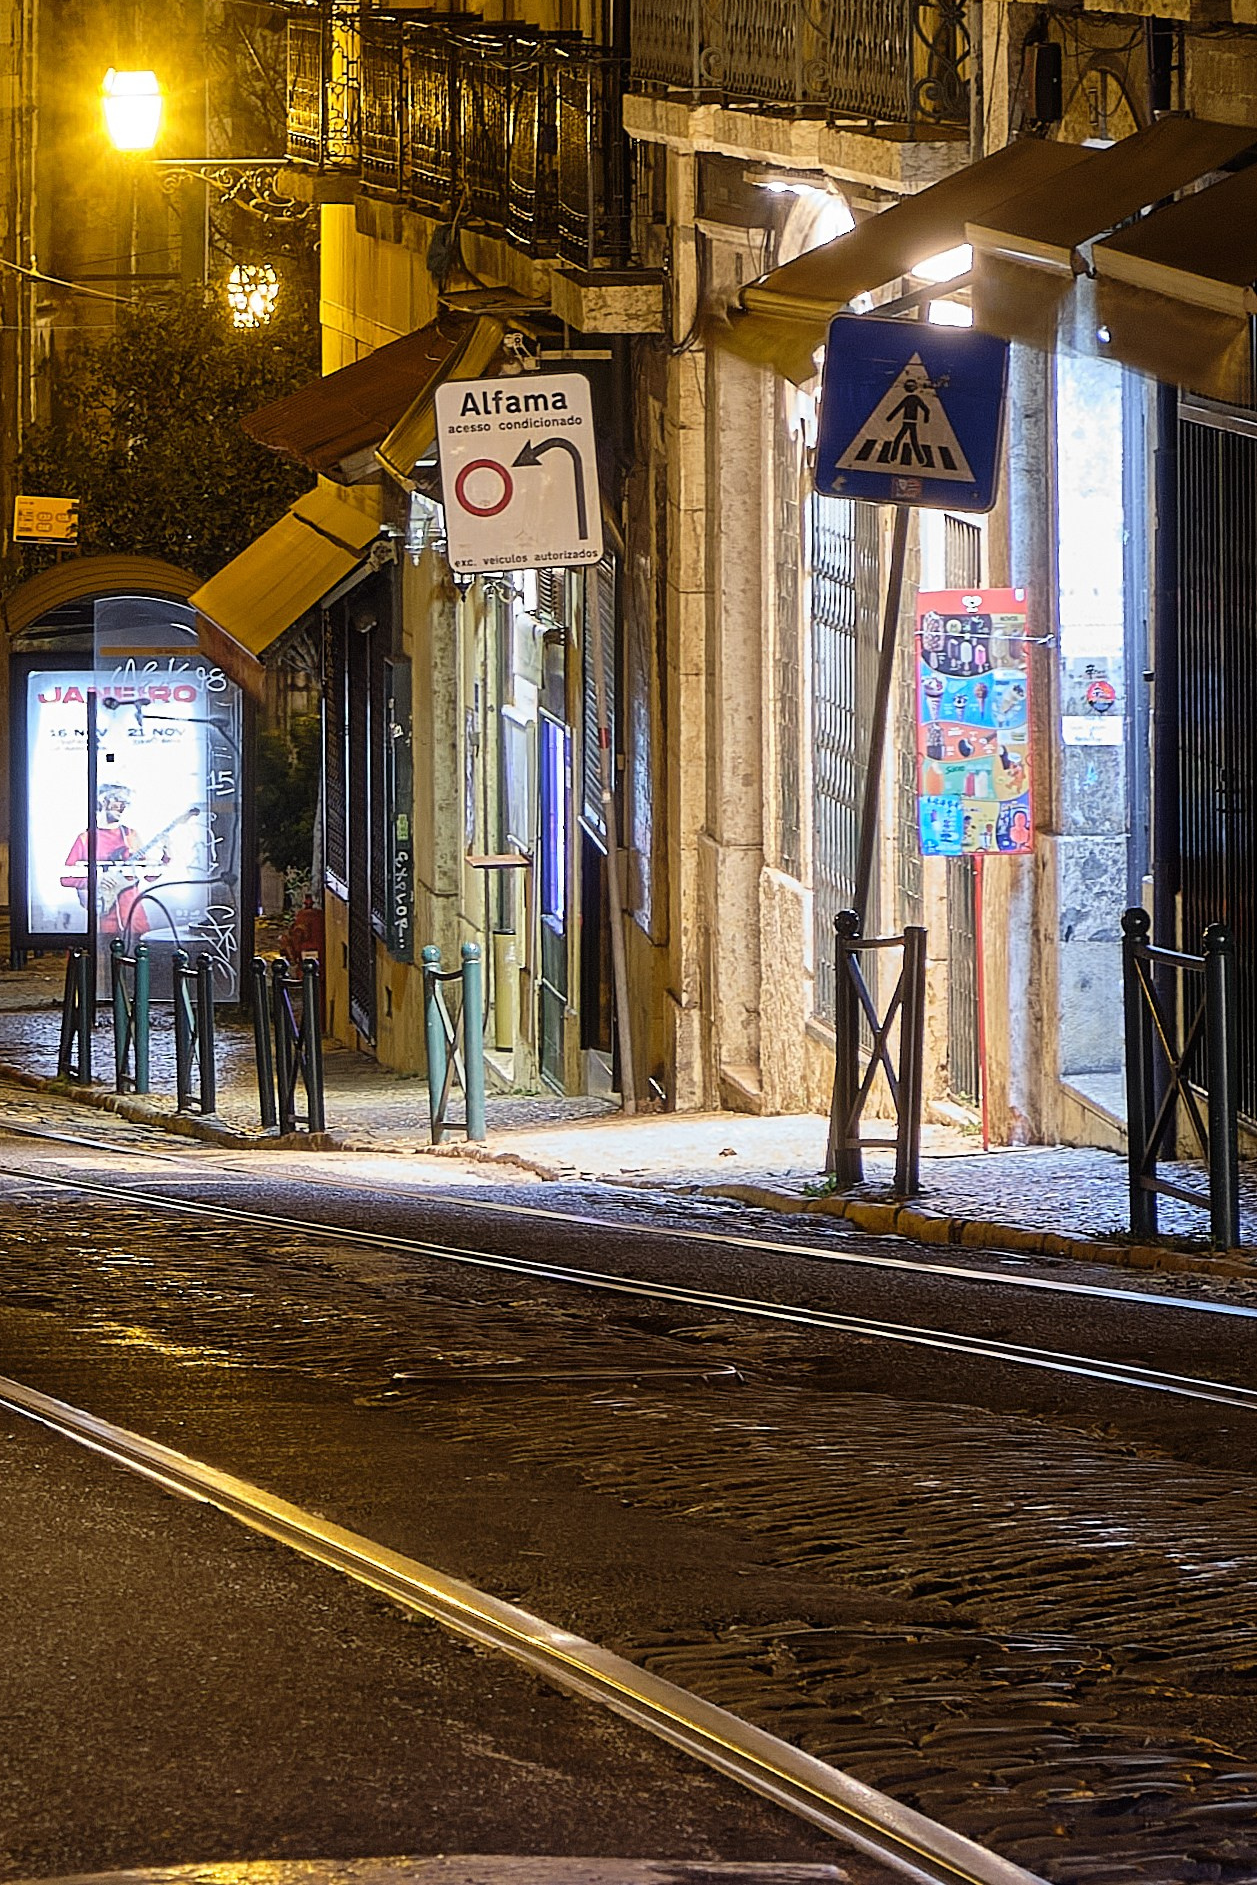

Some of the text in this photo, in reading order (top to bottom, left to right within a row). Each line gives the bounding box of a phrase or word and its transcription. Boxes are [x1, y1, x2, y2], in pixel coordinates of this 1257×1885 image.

[460, 390, 568, 417] Alfama
[448, 415, 583, 434] acesso condicionado
[454, 557, 477, 568] exc.
[534, 548, 599, 562] autorizados
[127, 727, 185, 737] 21 NOV
